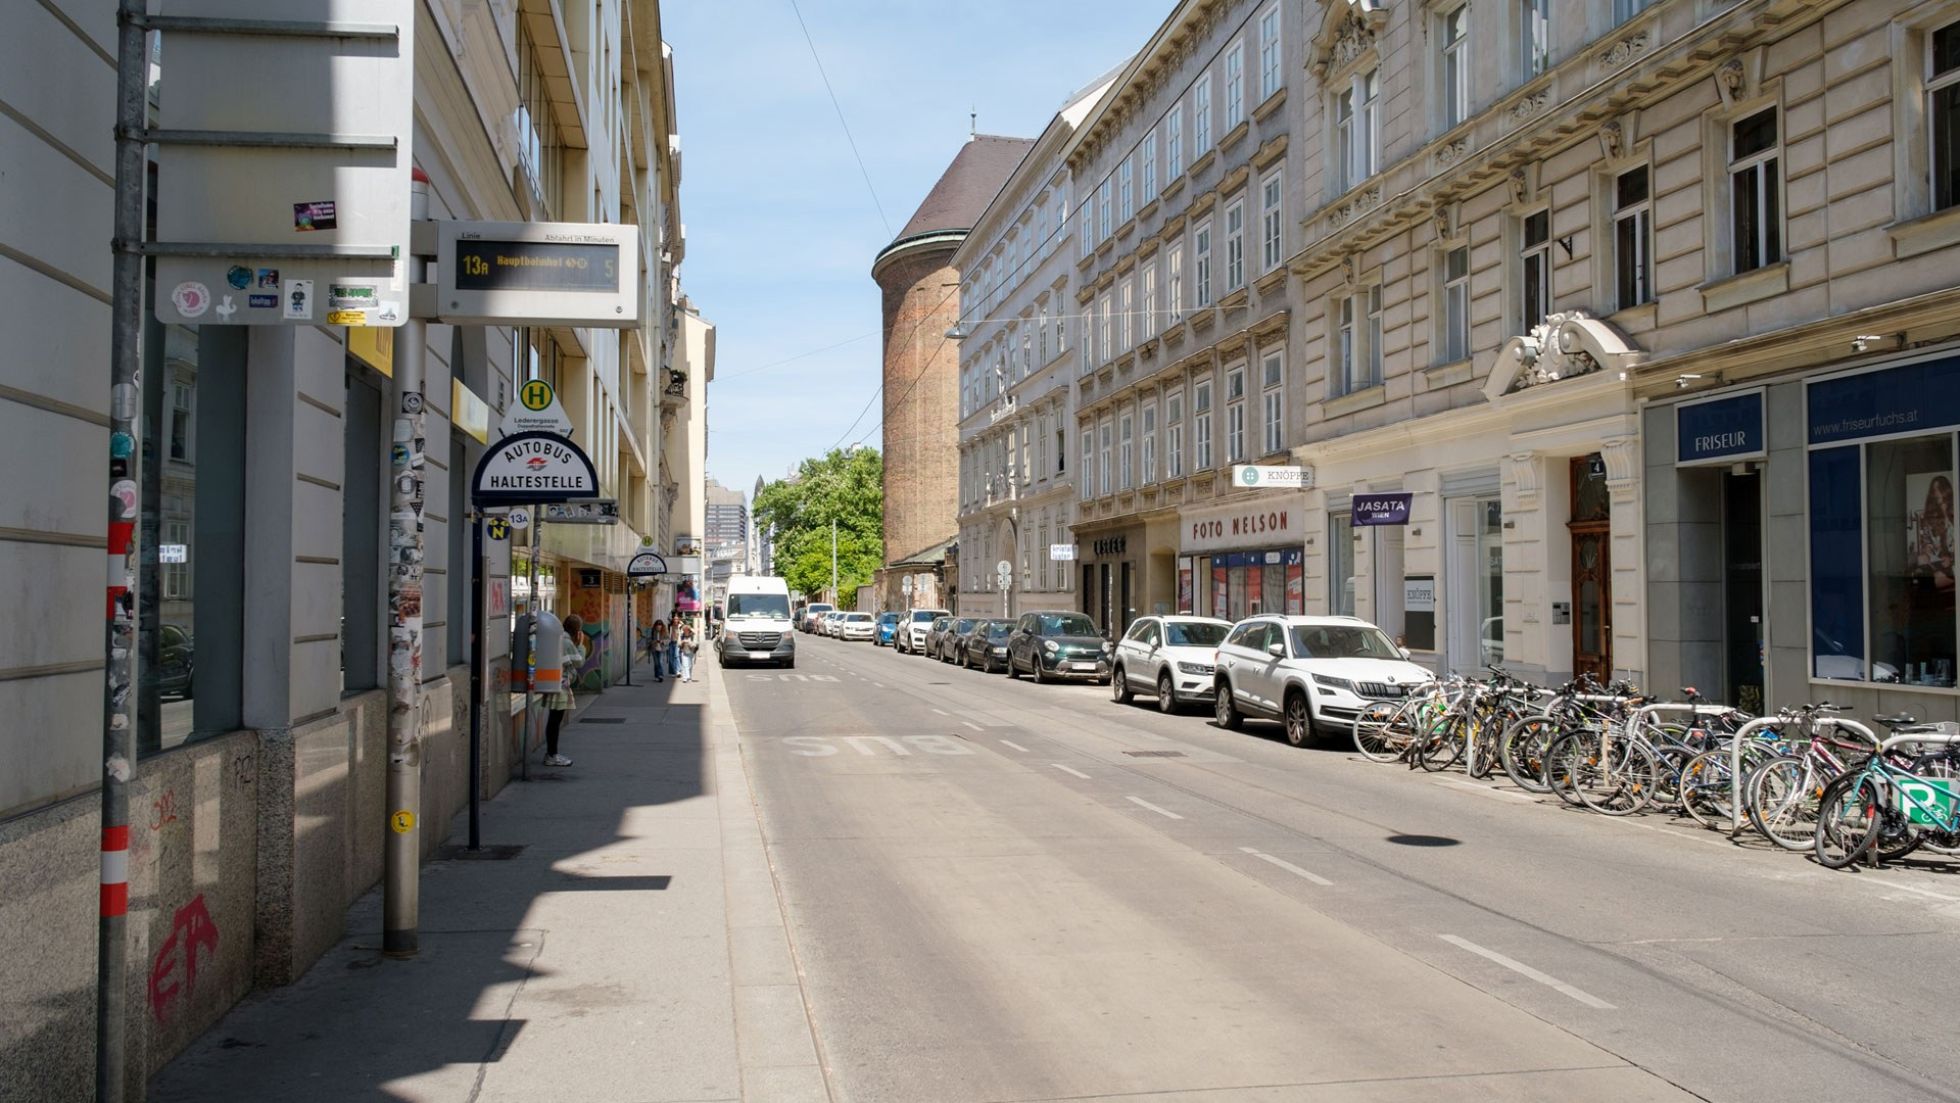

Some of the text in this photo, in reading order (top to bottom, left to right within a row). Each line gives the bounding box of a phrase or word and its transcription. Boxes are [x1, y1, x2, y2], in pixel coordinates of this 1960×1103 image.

[544, 233, 573, 242] Abfahrt
[584, 236, 615, 244] Minuten
[463, 254, 489, 275] 13A
[496, 255, 563, 268] Hauptbahnhof
[604, 259, 613, 278] 5
[528, 386, 545, 405] H
[1812, 409, 1919, 436] www.friseurfuchs.at
[1695, 430, 1746, 453] FRISEUR
[504, 441, 572, 464] AUTOBUS
[1594, 462, 1600, 473] 4
[1267, 470, 1309, 480] KNÖPFE
[490, 476, 582, 488] HALTESTELLE
[1357, 501, 1405, 512] JASATA
[510, 514, 528, 523] 13A
[1371, 511, 1390, 519] WIEN
[1193, 511, 1288, 540] FOTO NELSON
[492, 526, 504, 539] N
[746, 674, 841, 682] BUS
[782, 735, 975, 757] BUS
[1902, 783, 1936, 820] P
